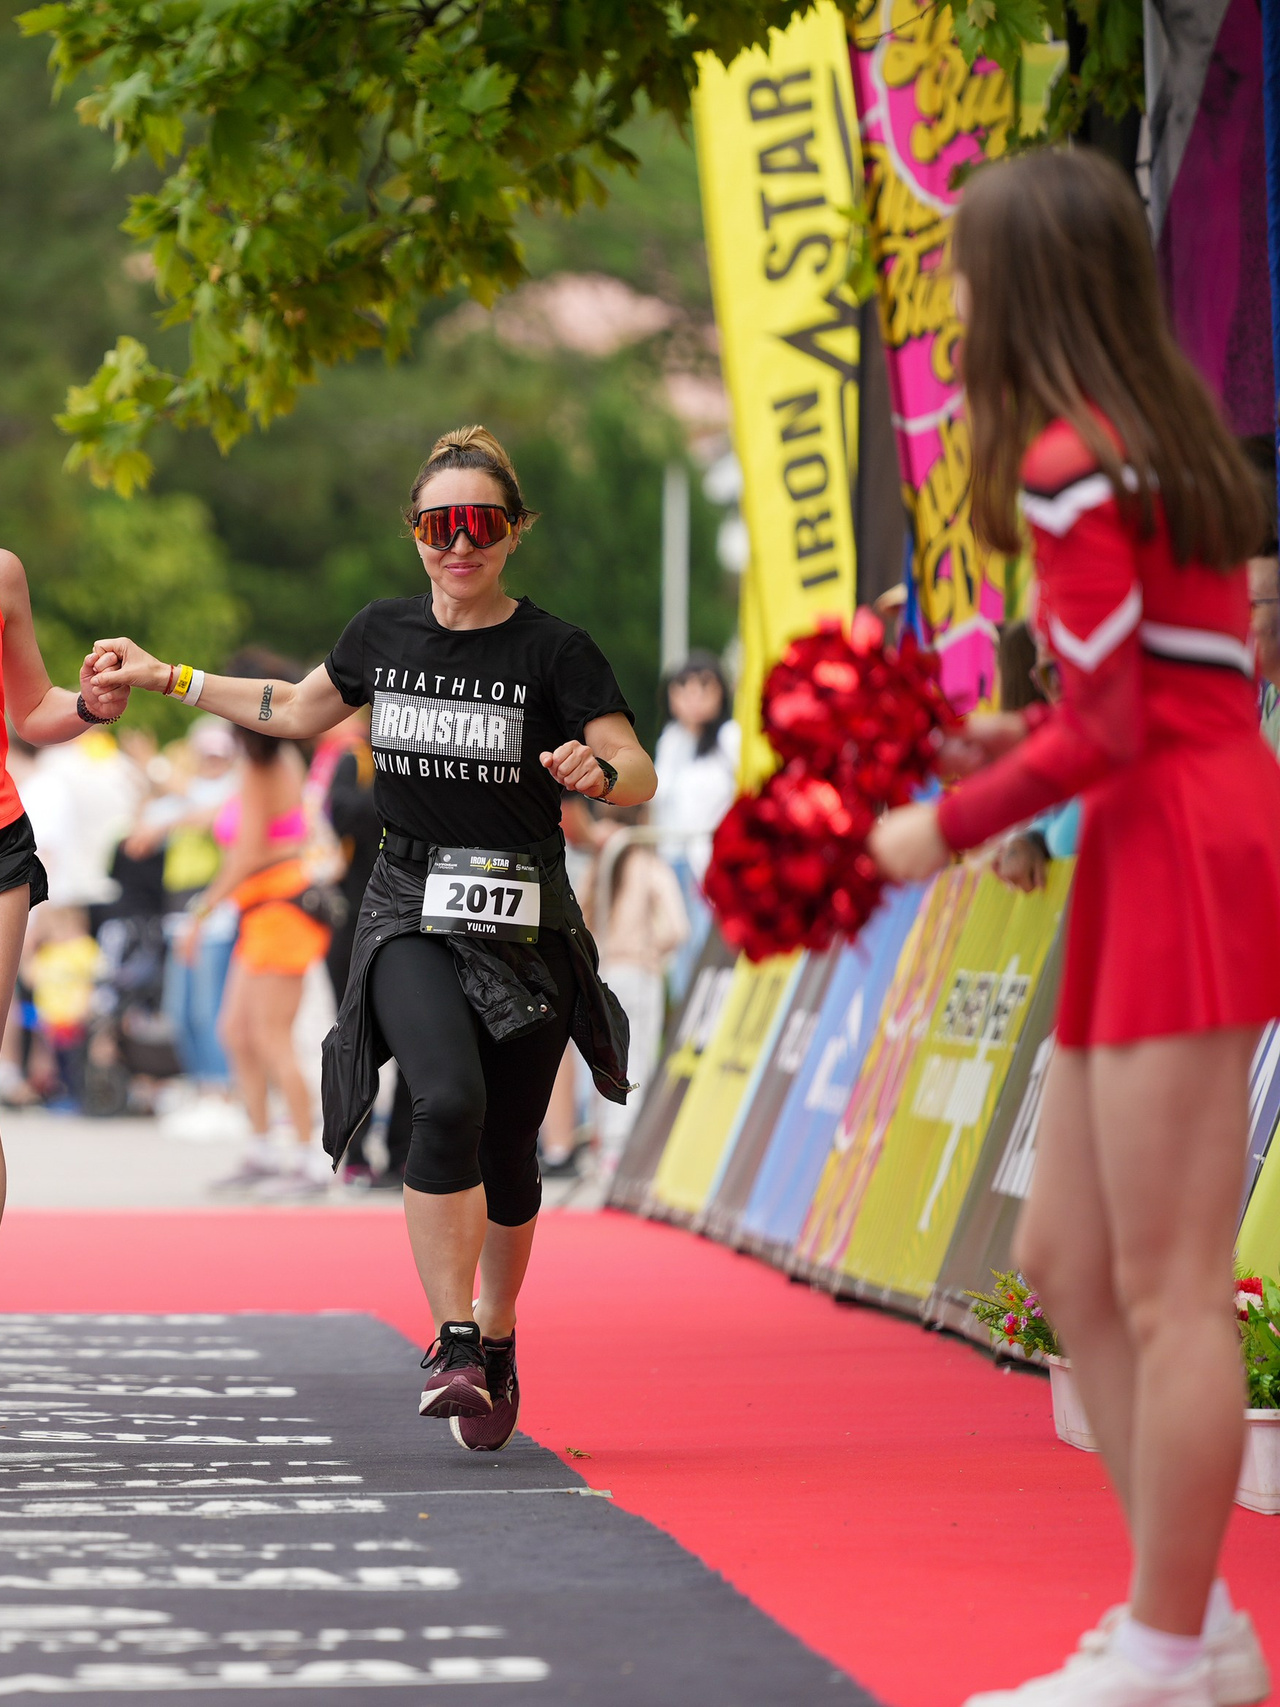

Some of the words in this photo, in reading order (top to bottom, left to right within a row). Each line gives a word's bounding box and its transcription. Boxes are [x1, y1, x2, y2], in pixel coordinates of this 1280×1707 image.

[747, 66, 834, 283] STAR
[771, 388, 840, 590] IRON
[374, 667, 527, 705] TRIATHLON
[377, 702, 507, 750] IRONSTAR
[418, 758, 470, 781] BIKE
[477, 764, 521, 784] RUN
[469, 856, 487, 865] IRON
[492, 857, 510, 868] STAR
[445, 882, 524, 918] 2017
[466, 921, 497, 934] YULIYA
